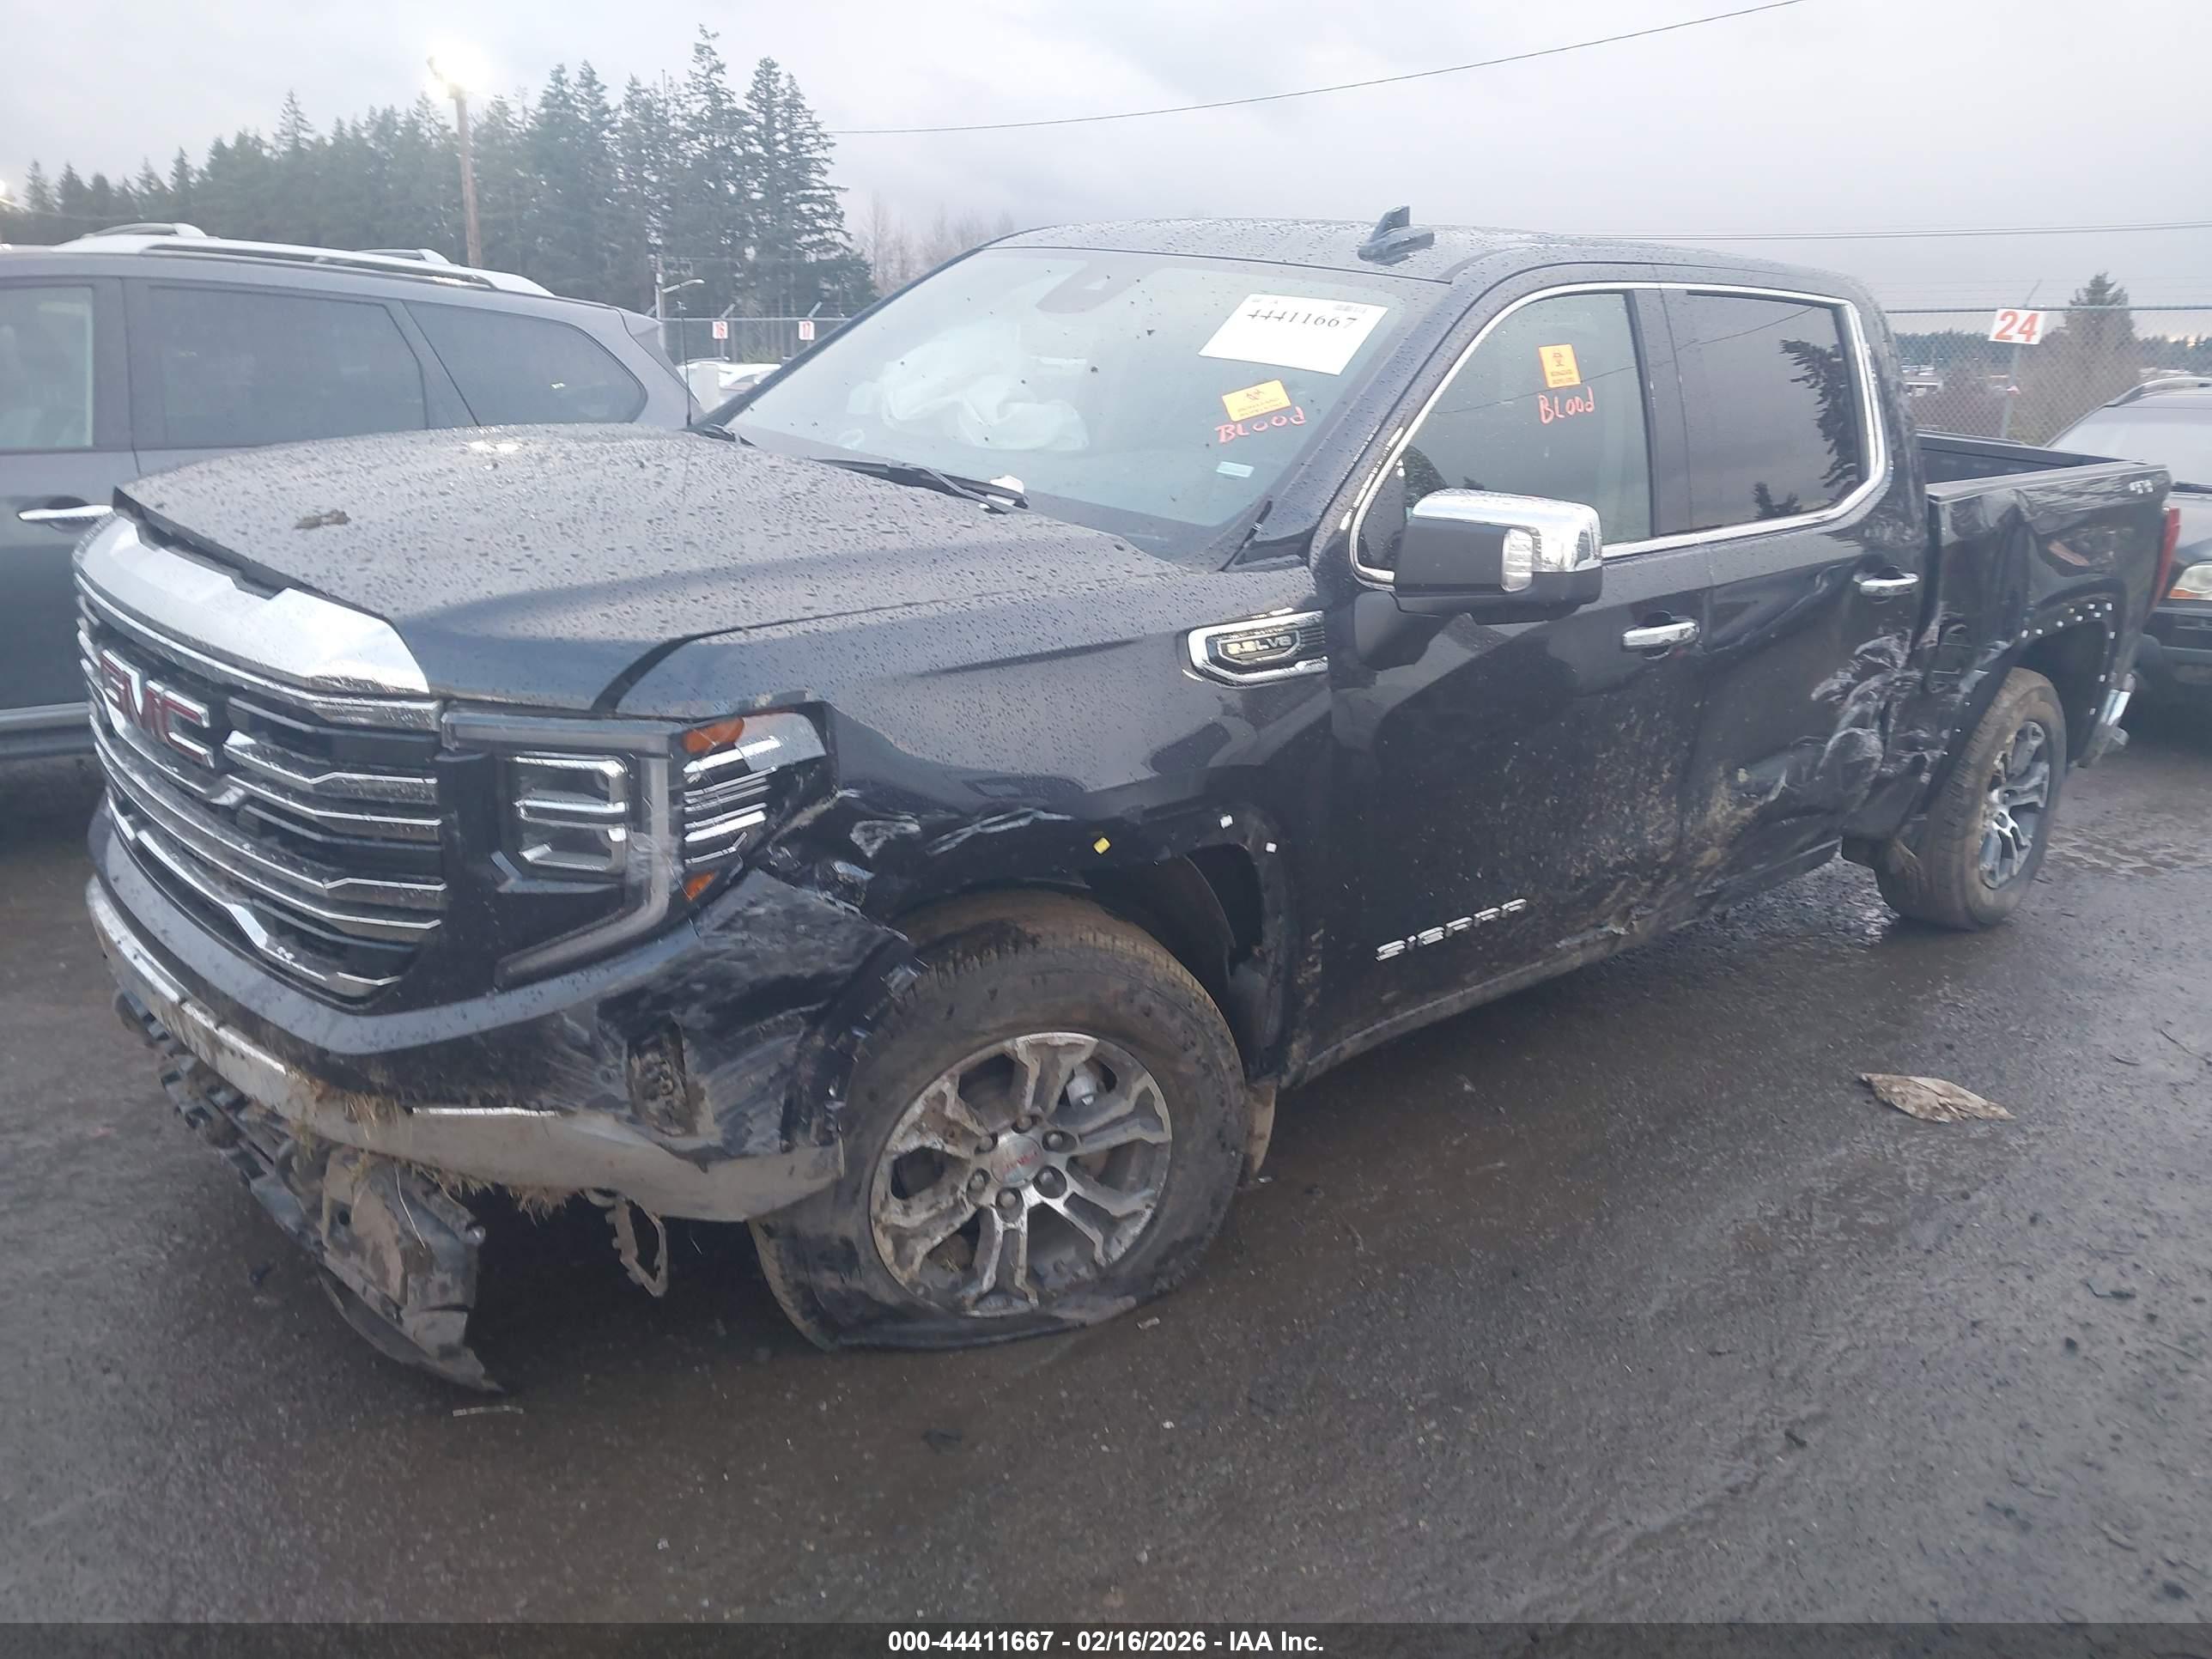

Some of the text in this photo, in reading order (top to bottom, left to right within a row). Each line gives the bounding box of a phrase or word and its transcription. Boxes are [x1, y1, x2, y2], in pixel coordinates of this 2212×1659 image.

[1246, 308, 1358, 329] 44411667
[1994, 310, 2040, 342] 24
[100, 649, 215, 769] GMC
[1375, 898, 1528, 962] SIERRA
